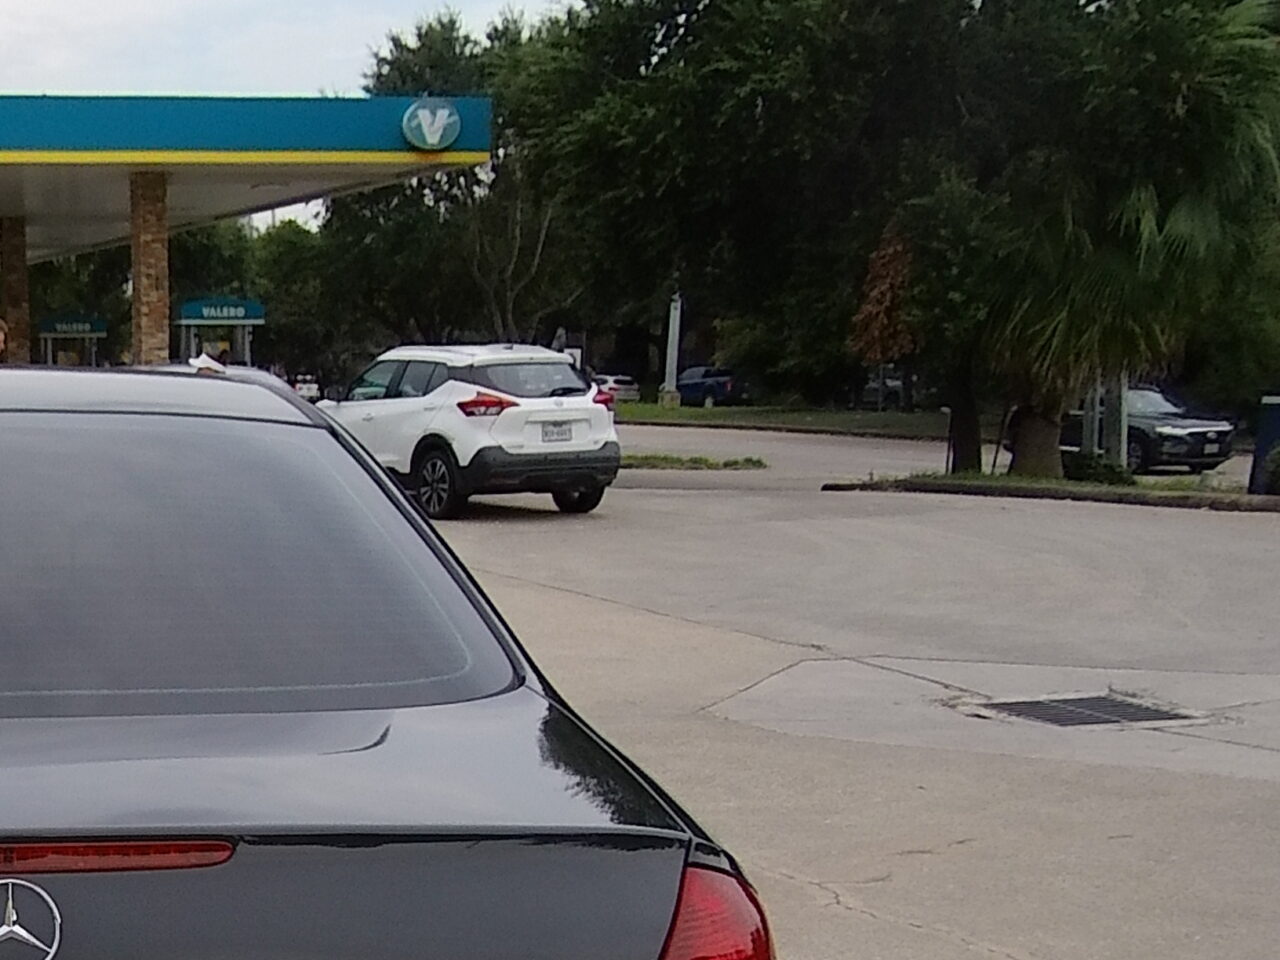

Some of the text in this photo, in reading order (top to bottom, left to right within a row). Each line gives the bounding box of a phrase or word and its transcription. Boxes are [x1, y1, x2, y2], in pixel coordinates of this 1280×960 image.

[417, 108, 450, 145] V
[202, 306, 245, 318] VALERO
[55, 322, 92, 333] VALERO
